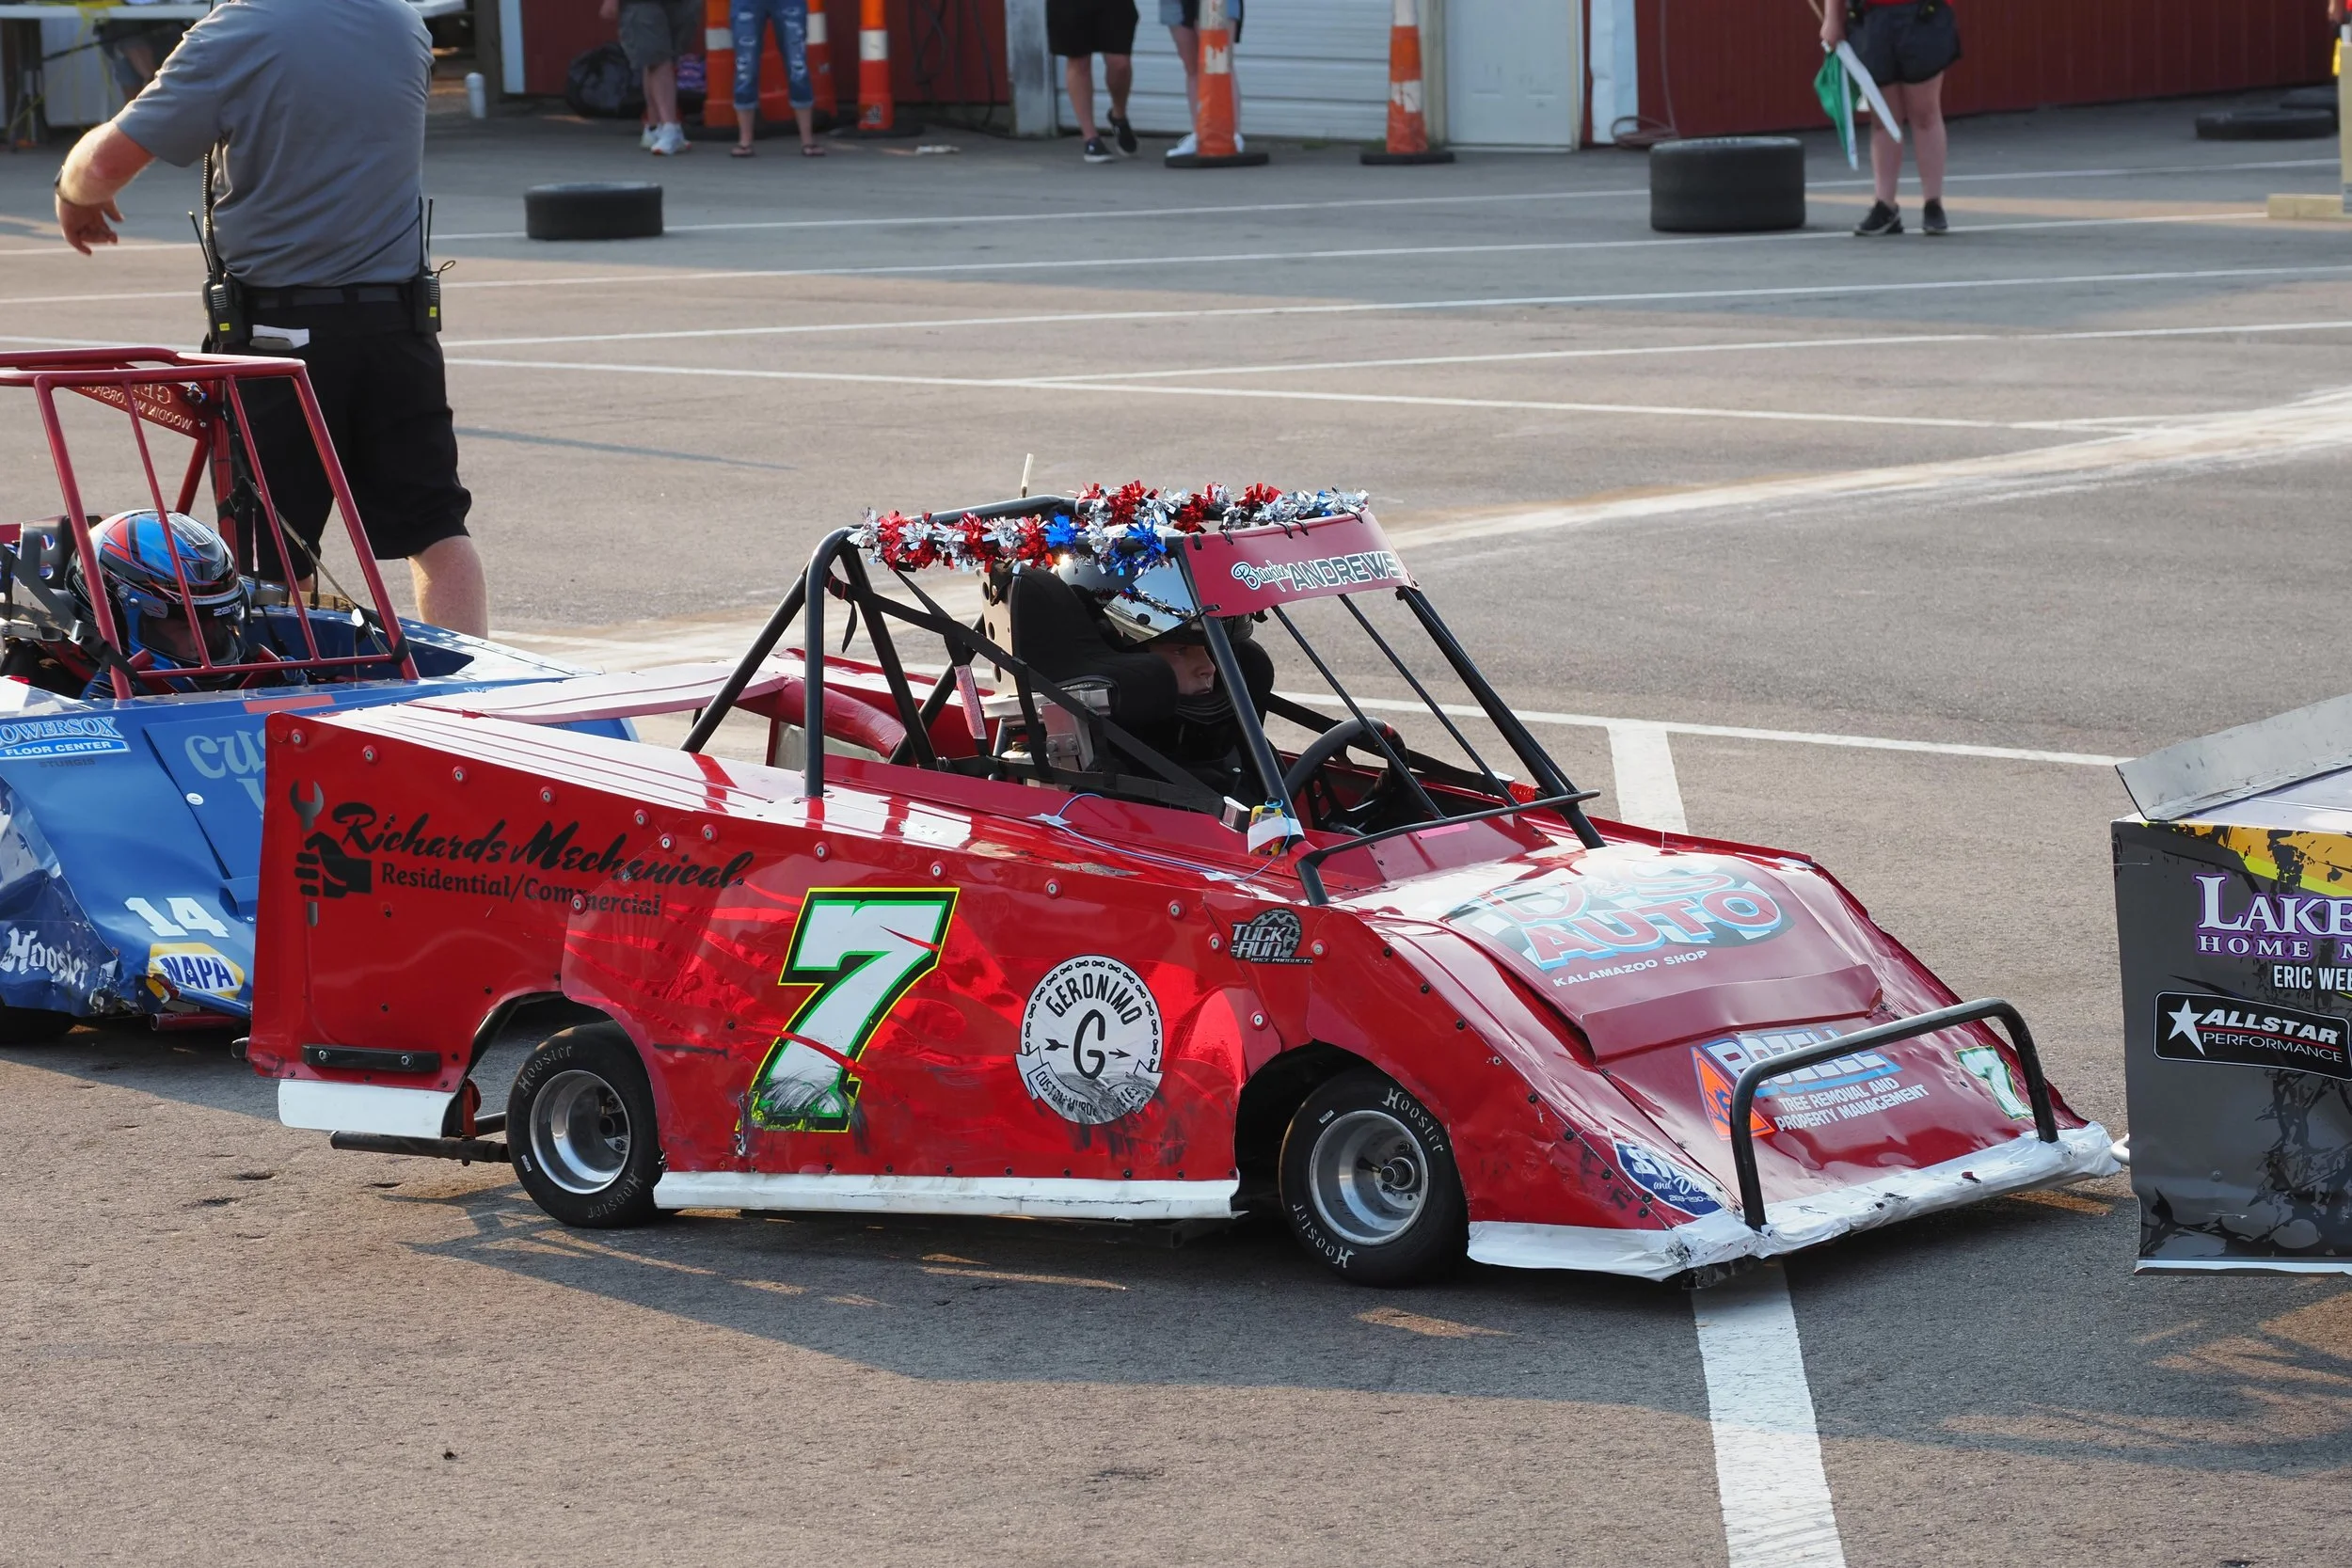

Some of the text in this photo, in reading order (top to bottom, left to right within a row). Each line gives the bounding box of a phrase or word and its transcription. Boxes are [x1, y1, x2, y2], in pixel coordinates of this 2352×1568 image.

[1231, 551, 1403, 592] Brayden ANDREWS
[0, 716, 124, 745] OWERSOX
[5, 741, 112, 756] FLOOR CENTER
[332, 802, 756, 888] Richards Mechanical
[381, 863, 661, 916] Residential/Commercial
[123, 897, 229, 939] 14
[1232, 924, 1287, 942] TUCK
[1521, 888, 1783, 968] AUTO
[0, 927, 89, 990] Hoosier
[1552, 949, 1708, 988] KALAMAZOO SHOP
[2198, 935, 2310, 958] HOME
[160, 956, 235, 990] NAPA
[2273, 965, 2312, 990] ERIC
[736, 887, 960, 1132] 7
[1045, 973, 1143, 1025] GERONIMO
[1073, 1009, 1105, 1080] G
[2201, 1008, 2339, 1045] ALLSTAR
[2202, 1032, 2343, 1063] PERFORMANCE
[517, 1045, 572, 1098] Hoosier
[1777, 1077, 1900, 1112] TREE REMOVAL AND
[1954, 1045, 2034, 1120] 7
[1381, 1087, 1445, 1152] Hoosier
[1773, 1085, 1930, 1132] PROPERTY MANAGEMENT
[588, 1168, 644, 1219] Hoosier
[1292, 1203, 1356, 1269] Hoosier
